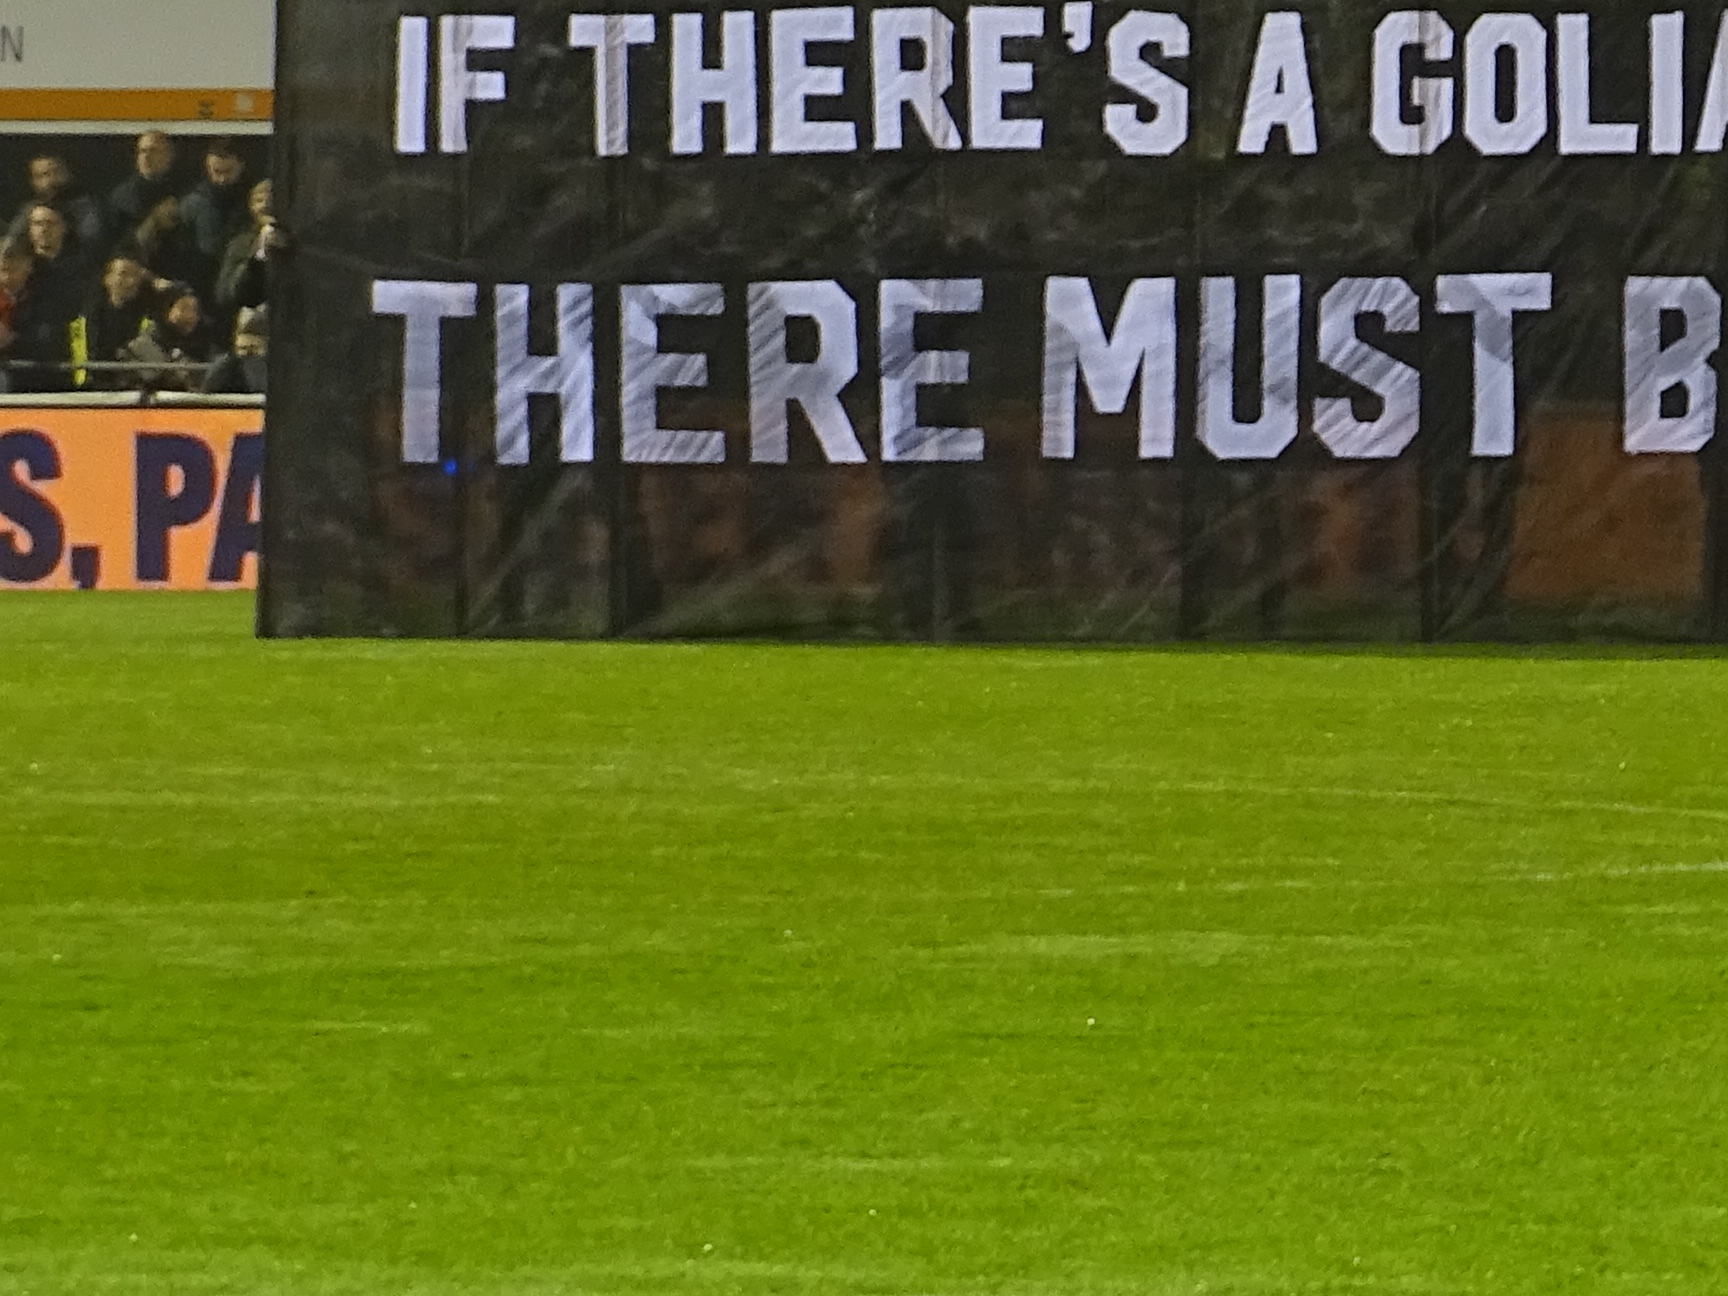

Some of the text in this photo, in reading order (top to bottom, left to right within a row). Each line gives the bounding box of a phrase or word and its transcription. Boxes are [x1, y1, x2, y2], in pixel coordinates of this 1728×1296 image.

[393, 13, 517, 156] IF
[568, 0, 1191, 157] THERE'S
[1236, 10, 1319, 156] A
[371, 276, 985, 465] THERE
[1040, 272, 1553, 461] MUST
